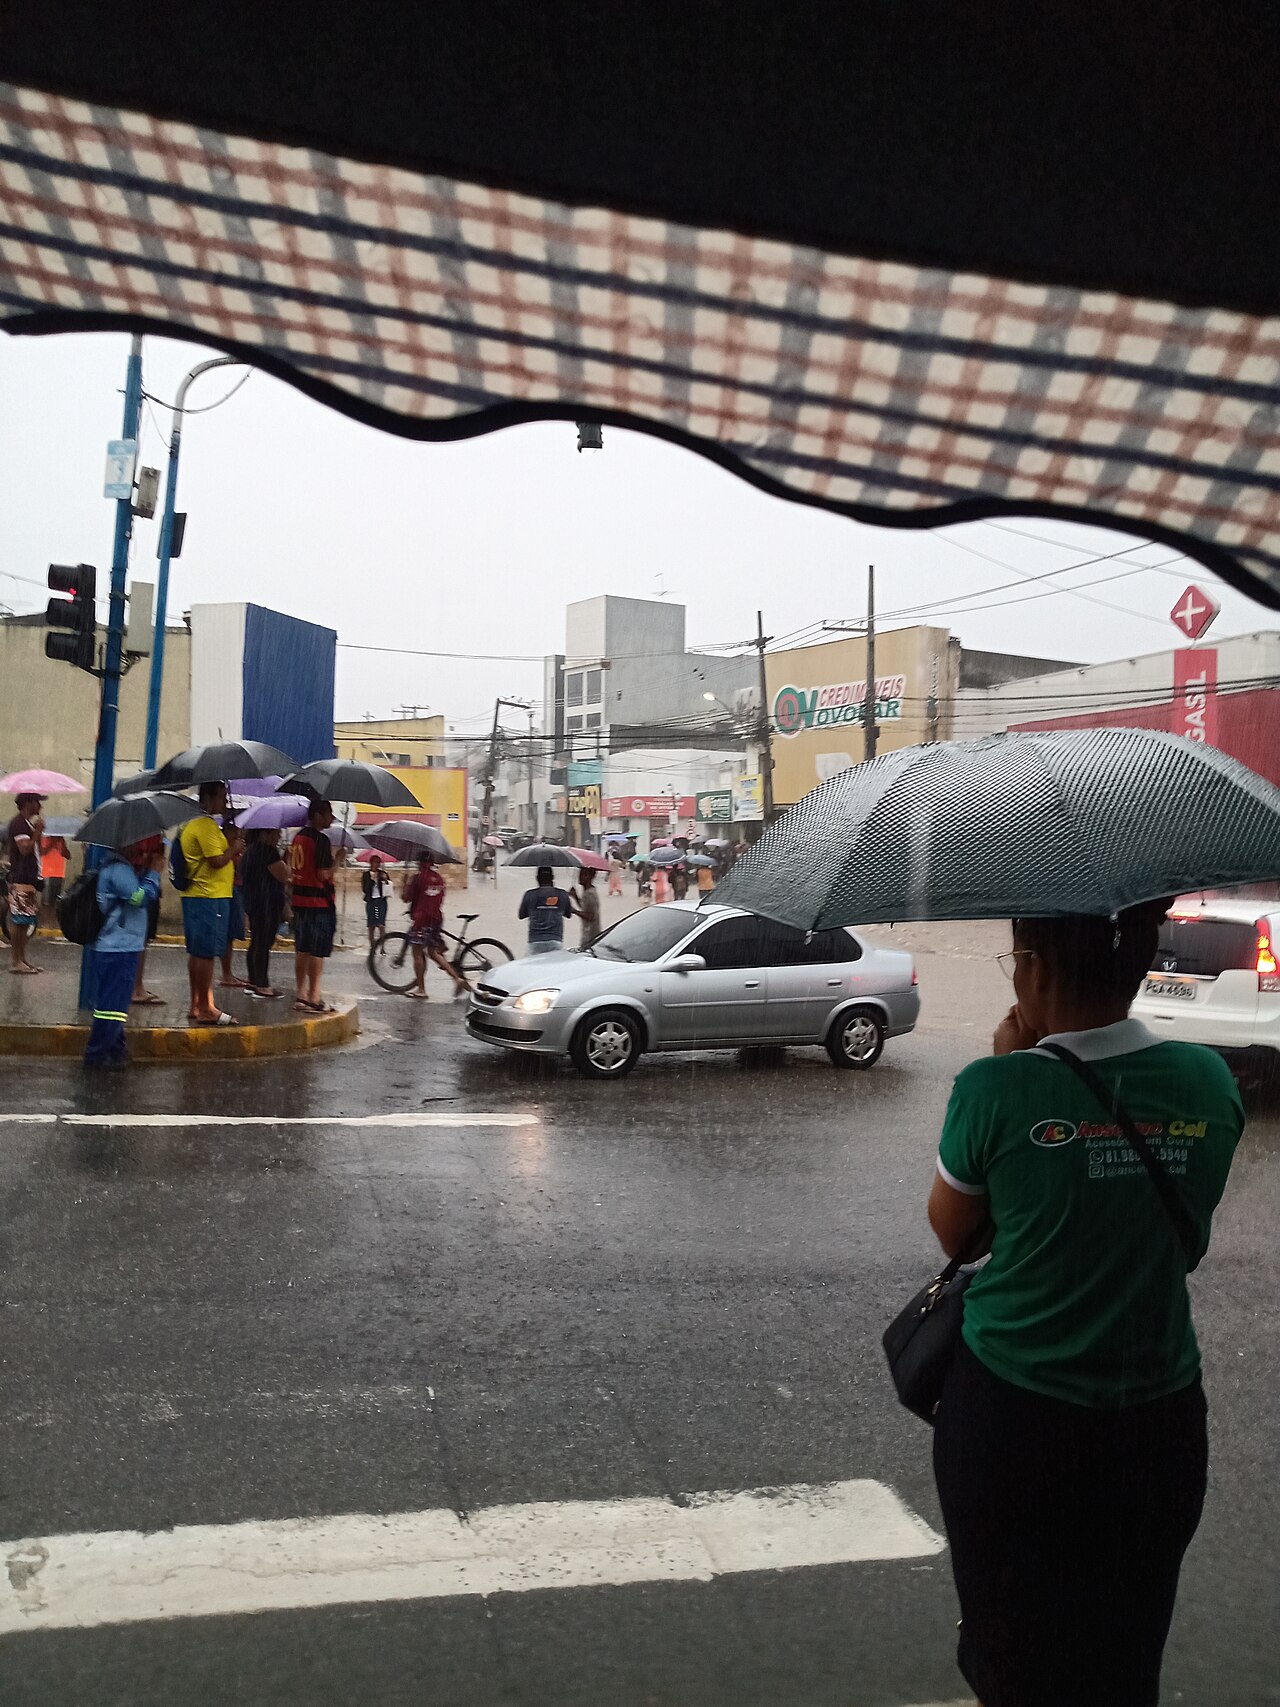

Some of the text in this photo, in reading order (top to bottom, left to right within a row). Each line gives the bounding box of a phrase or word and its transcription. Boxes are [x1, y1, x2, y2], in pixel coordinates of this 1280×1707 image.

[820, 677, 903, 708] CREDIMVEIS
[1040, 1123, 1067, 1142] AC
[1168, 1120, 1208, 1138] Cell
